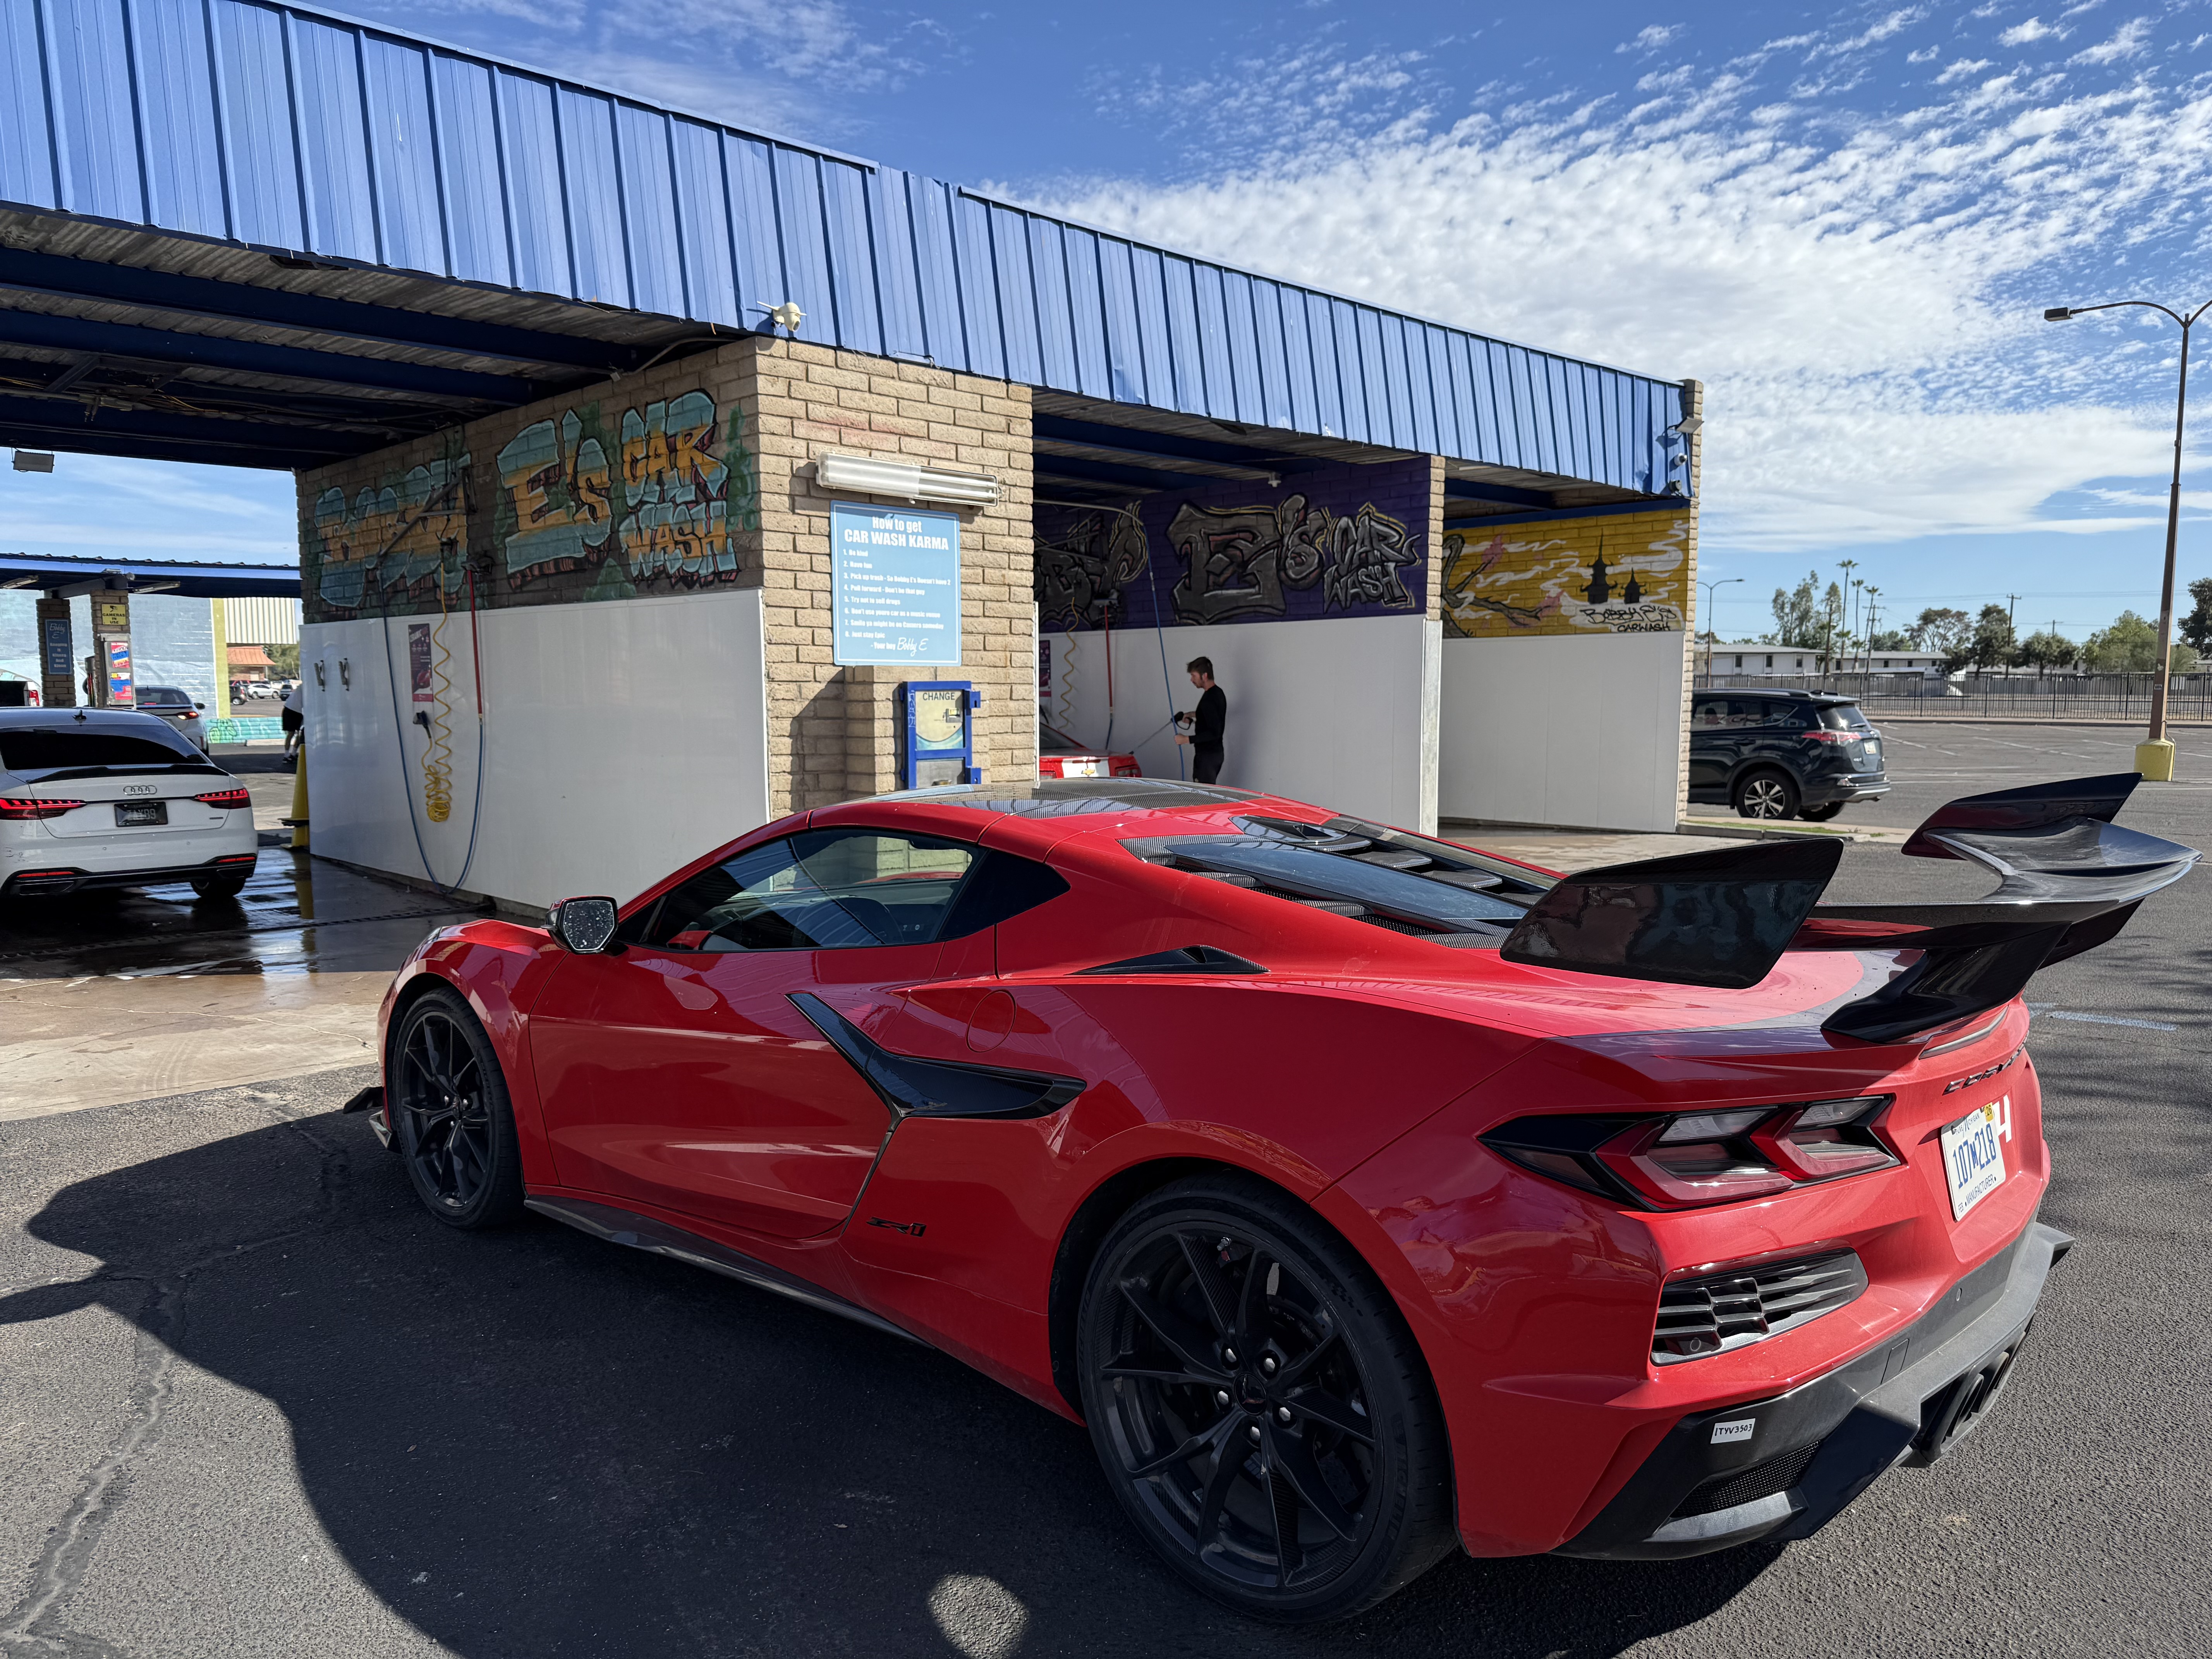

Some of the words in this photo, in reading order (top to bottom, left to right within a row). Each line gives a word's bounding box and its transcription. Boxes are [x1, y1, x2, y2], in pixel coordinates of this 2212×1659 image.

[620, 388, 730, 507] CAR
[872, 516, 893, 530] How
[894, 519, 905, 531] to
[906, 521, 922, 533] get
[619, 500, 739, 588] WASH
[844, 529, 869, 544] CAR
[871, 531, 906, 547] WASH
[908, 534, 949, 550] KARMA
[1322, 562, 1410, 614] WASH
[1579, 607, 1644, 626] BOBBY
[897, 637, 917, 657] Bobby
[919, 638, 929, 651] E
[923, 692, 955, 701] CHANGE
[1986, 1104, 1992, 1116] 26
[1966, 1174, 1994, 1205] MANUFACTURER
